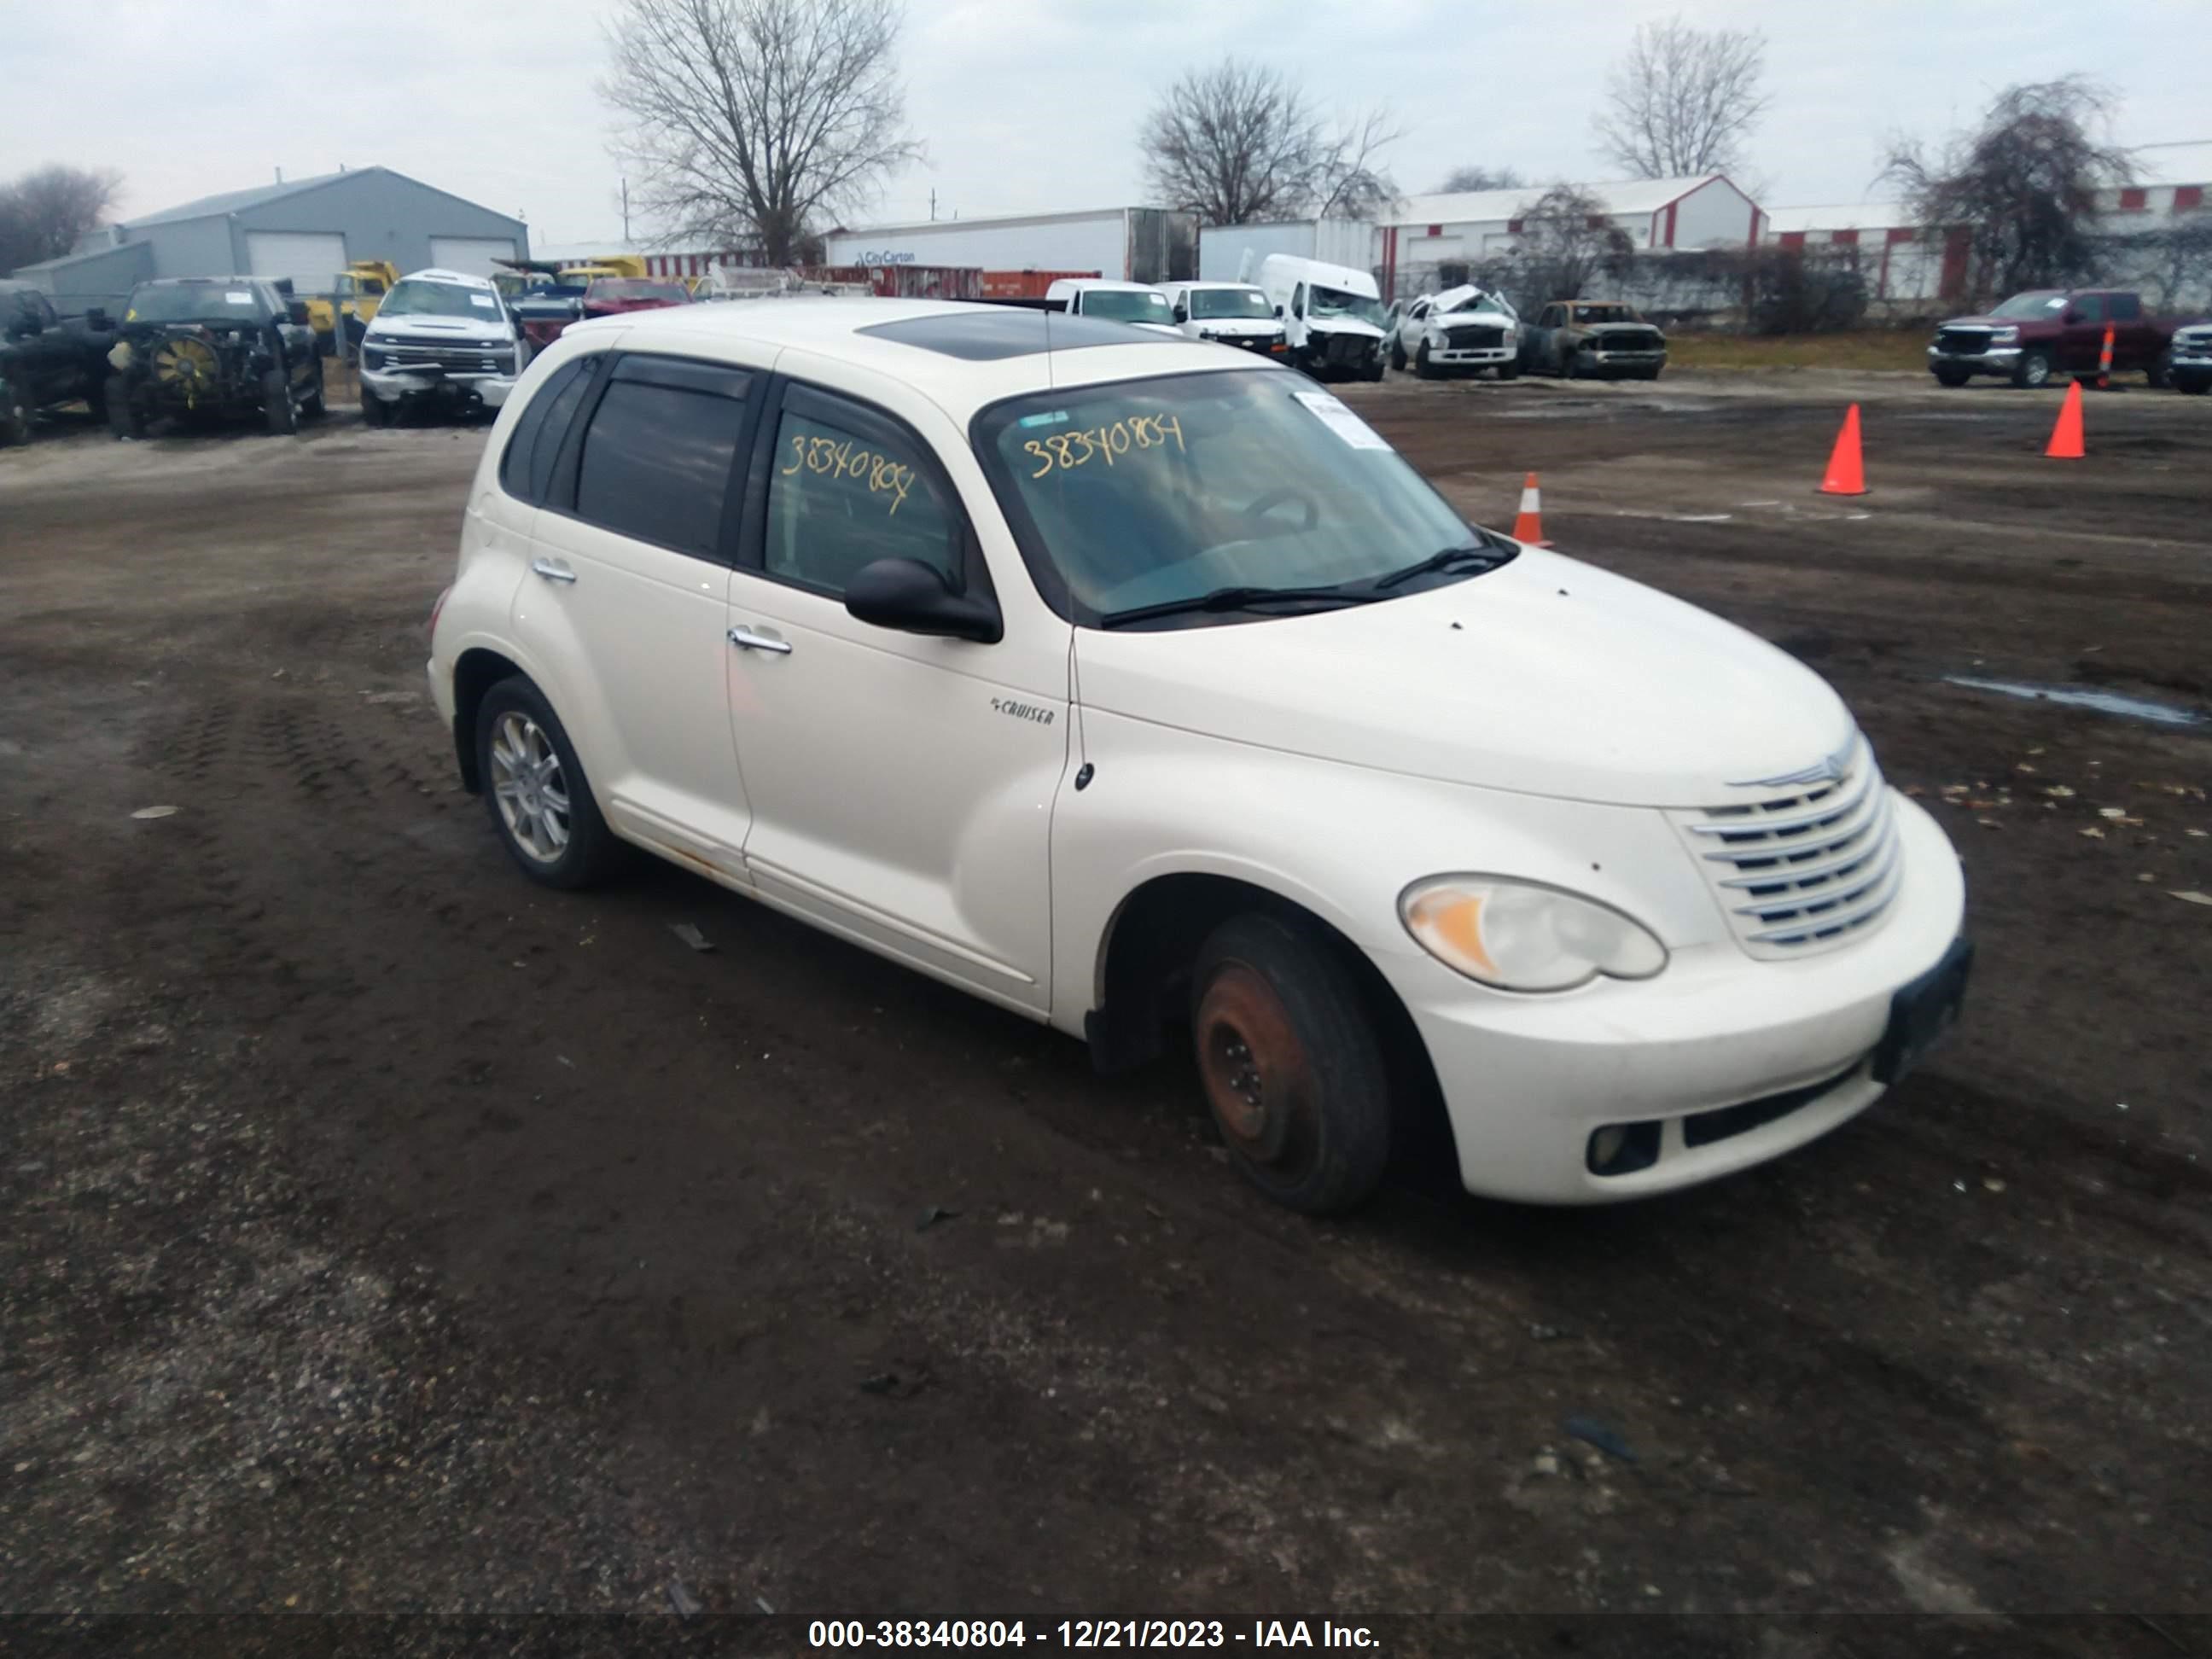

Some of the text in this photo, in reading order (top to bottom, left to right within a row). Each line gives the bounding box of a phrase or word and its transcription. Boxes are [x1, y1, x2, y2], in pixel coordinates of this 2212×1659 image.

[782, 435, 916, 515] 38340804
[1024, 413, 1186, 479] 38340804
[1001, 700, 1055, 725] CRUISER
